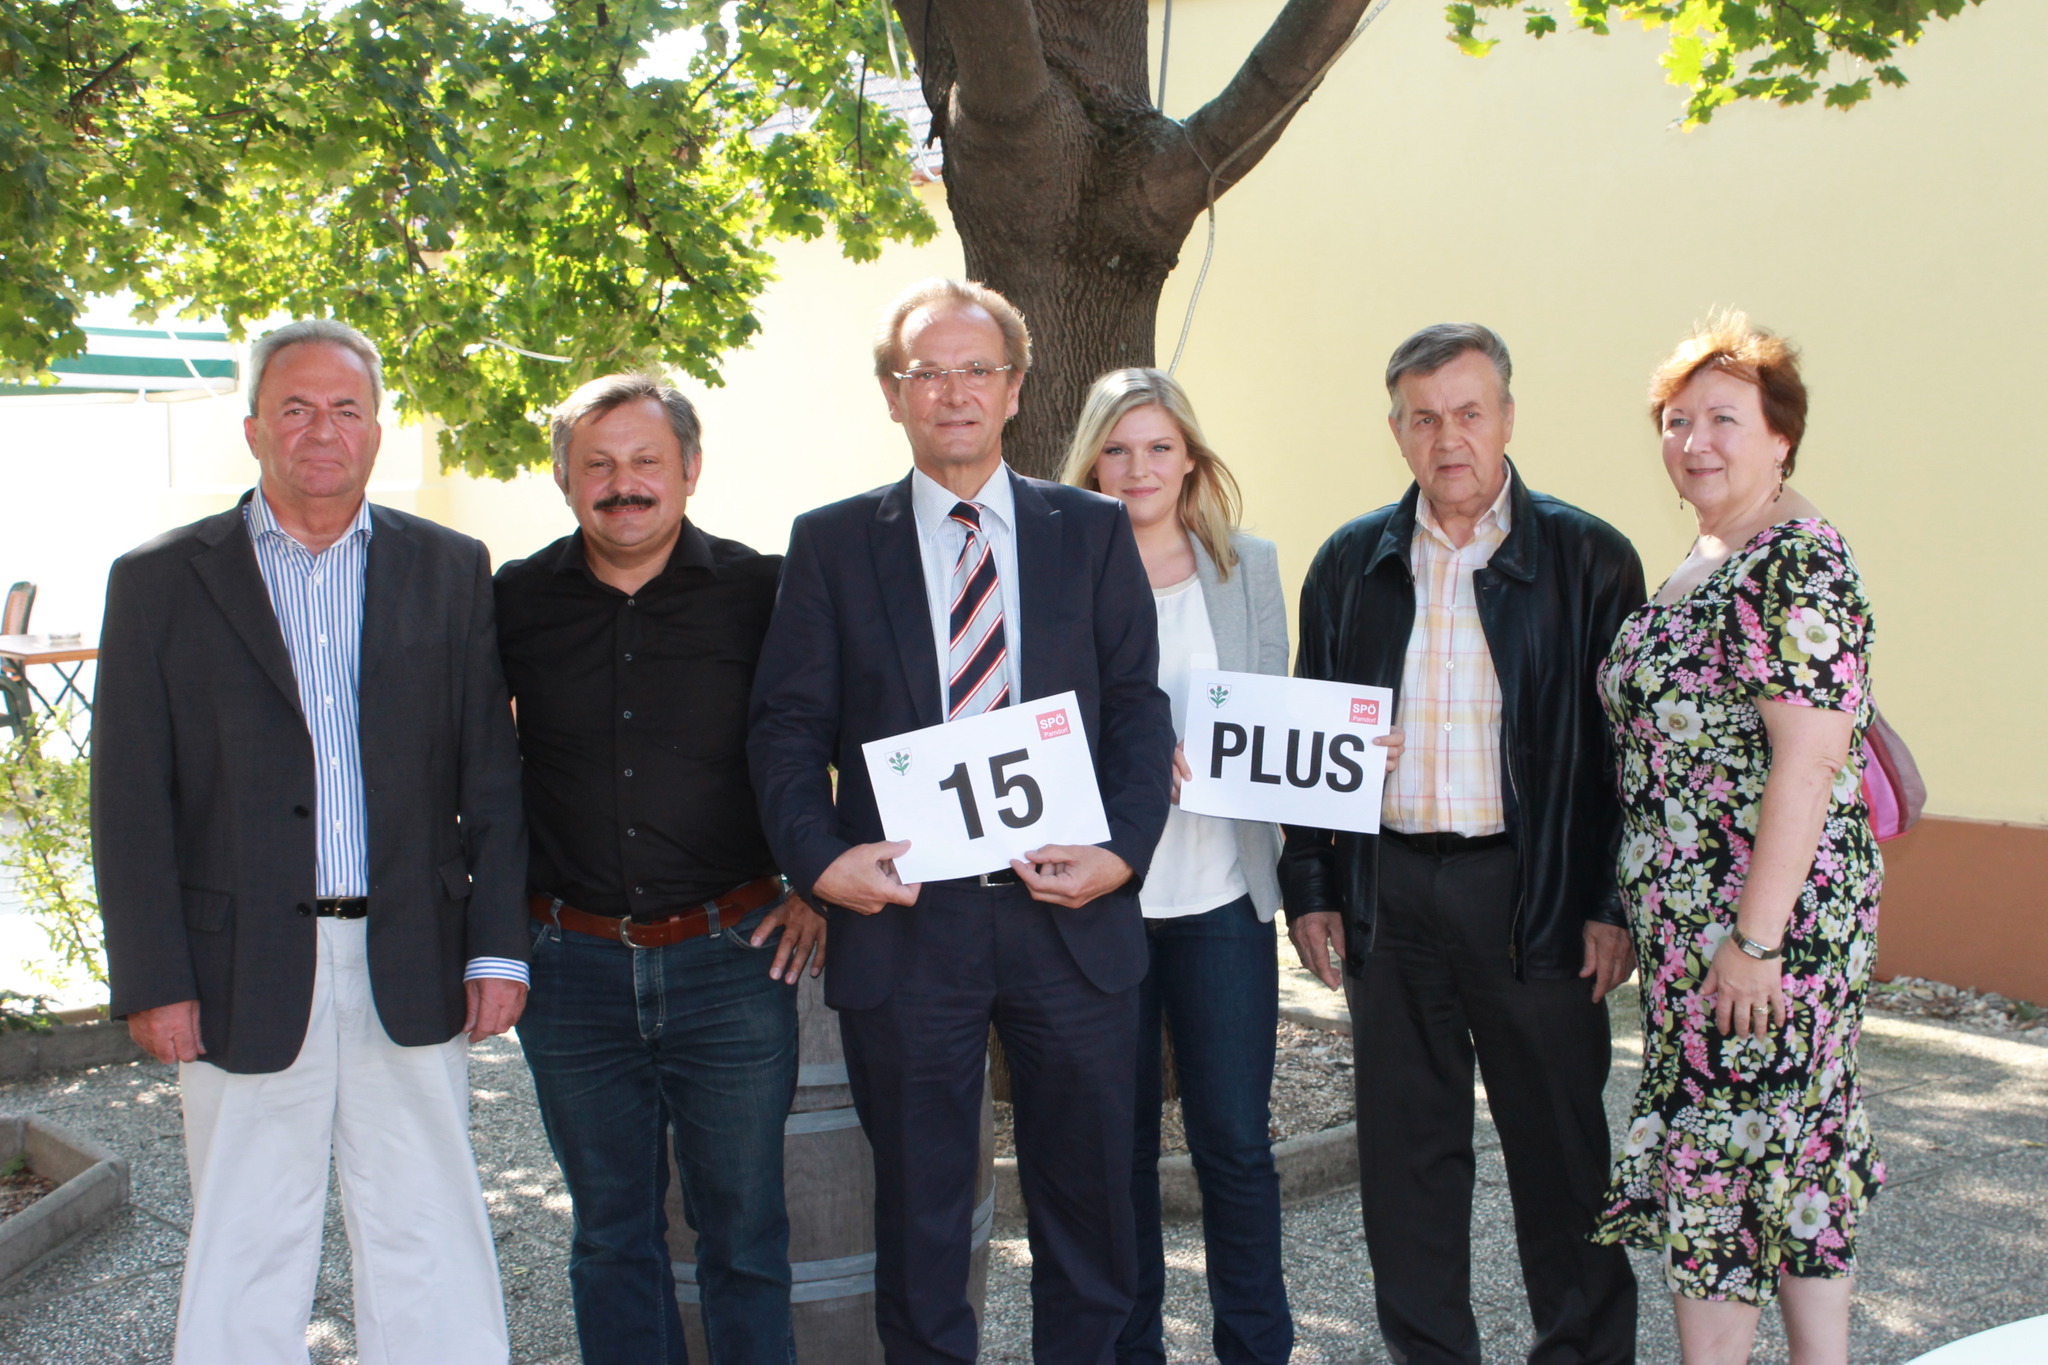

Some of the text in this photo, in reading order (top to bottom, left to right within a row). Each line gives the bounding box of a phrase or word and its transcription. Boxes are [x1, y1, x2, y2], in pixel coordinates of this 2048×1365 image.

[1040, 713, 1065, 730] SPÖ
[1352, 704, 1376, 715] SPÖ
[1210, 721, 1365, 793] PLUS
[938, 747, 1044, 841] 15
